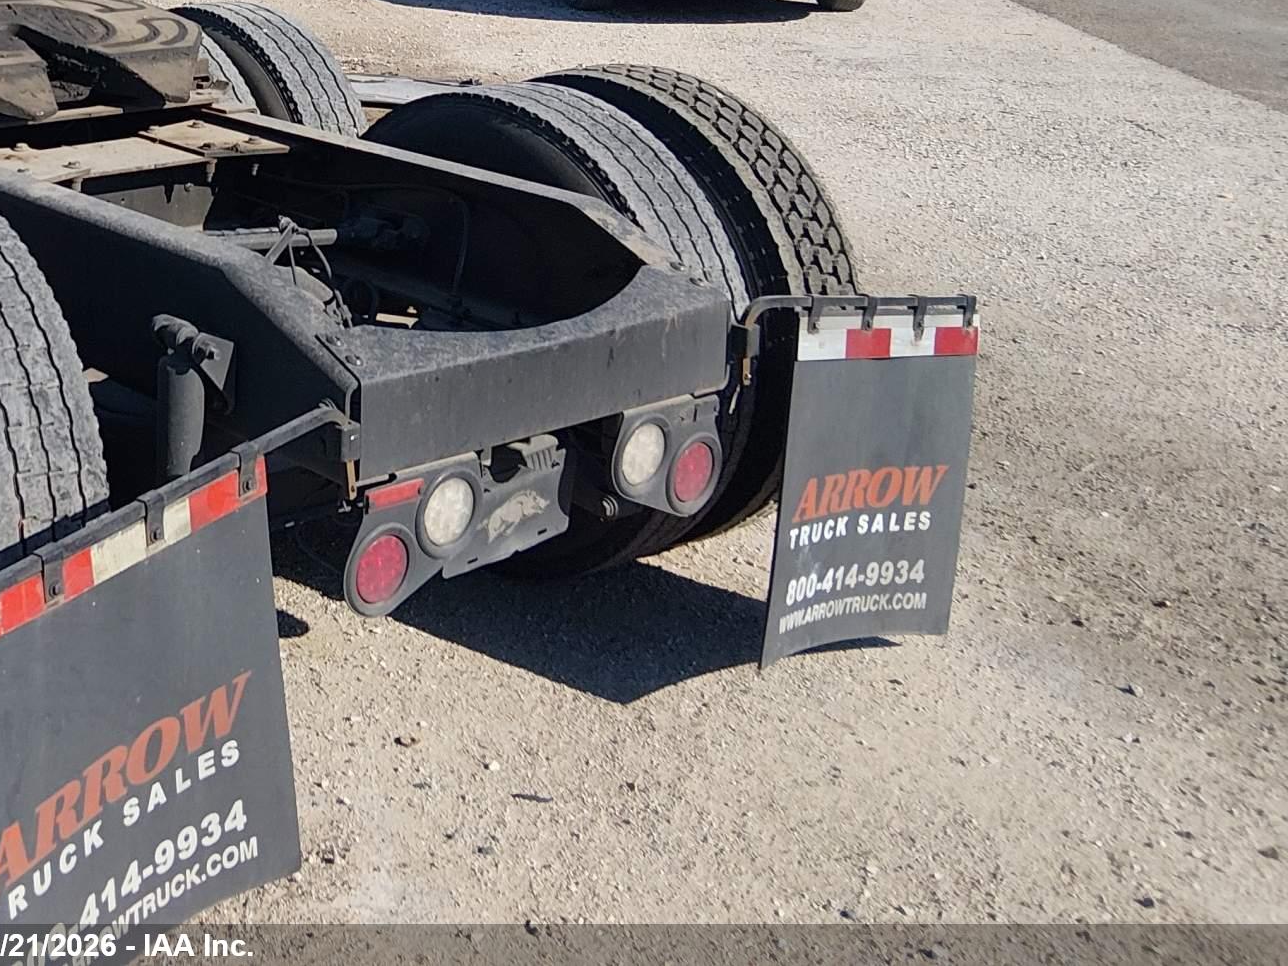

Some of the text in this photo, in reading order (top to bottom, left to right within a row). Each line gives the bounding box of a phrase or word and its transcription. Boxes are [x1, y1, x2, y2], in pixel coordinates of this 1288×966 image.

[792, 465, 950, 523] ARROW
[789, 511, 931, 550] TRUCK SALES
[786, 559, 925, 606] 800-414-9934
[779, 592, 927, 634] WWW.ARROWTRUCK.COM
[123, 739, 241, 826] SALES
